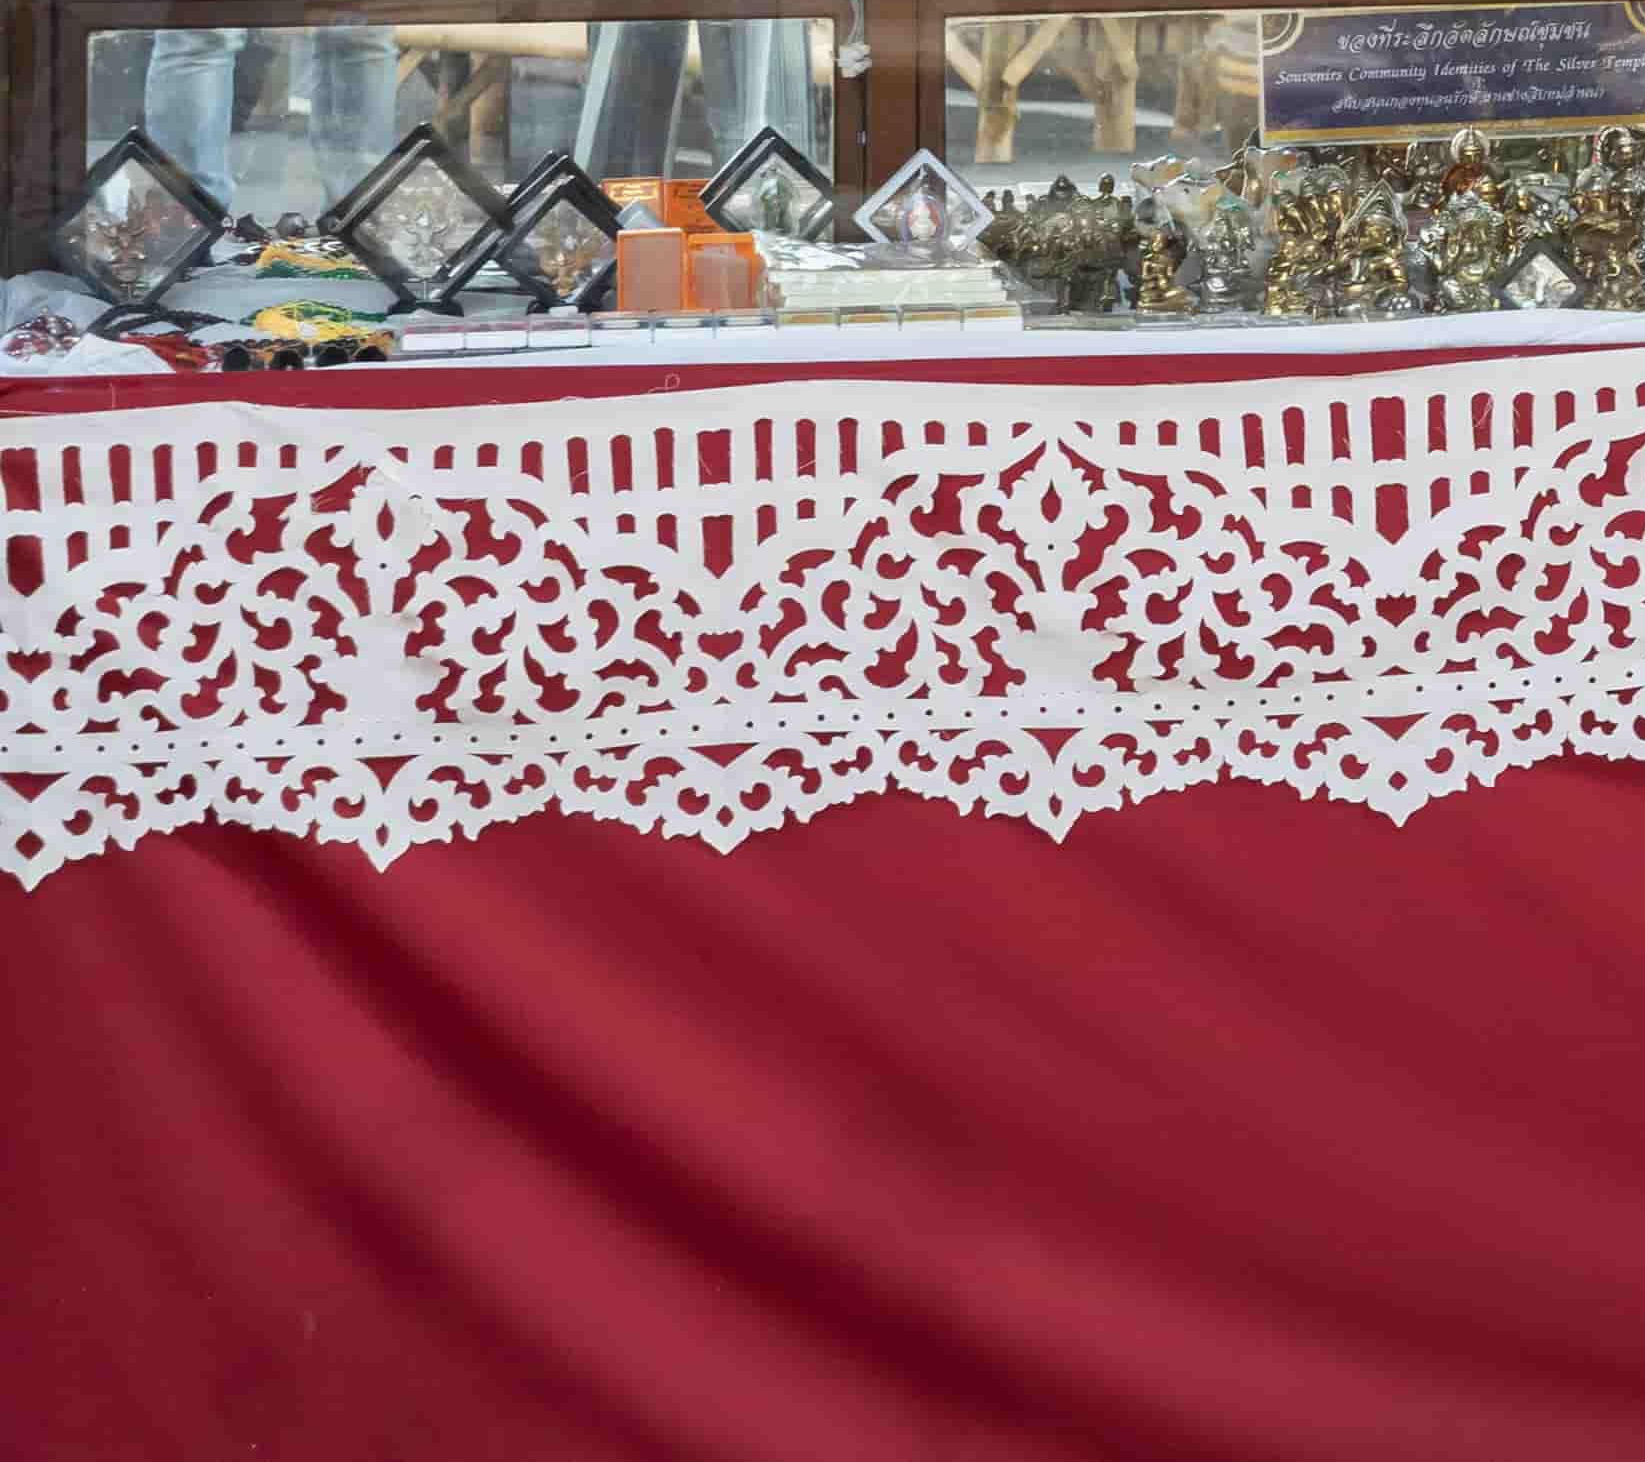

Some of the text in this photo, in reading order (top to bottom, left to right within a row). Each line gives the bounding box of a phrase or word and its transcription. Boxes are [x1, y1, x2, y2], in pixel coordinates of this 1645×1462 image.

[1349, 66, 1428, 83] Community
[1433, 59, 1498, 78] Identities
[1502, 59, 1517, 77] of
[1555, 55, 1598, 73] Silver
